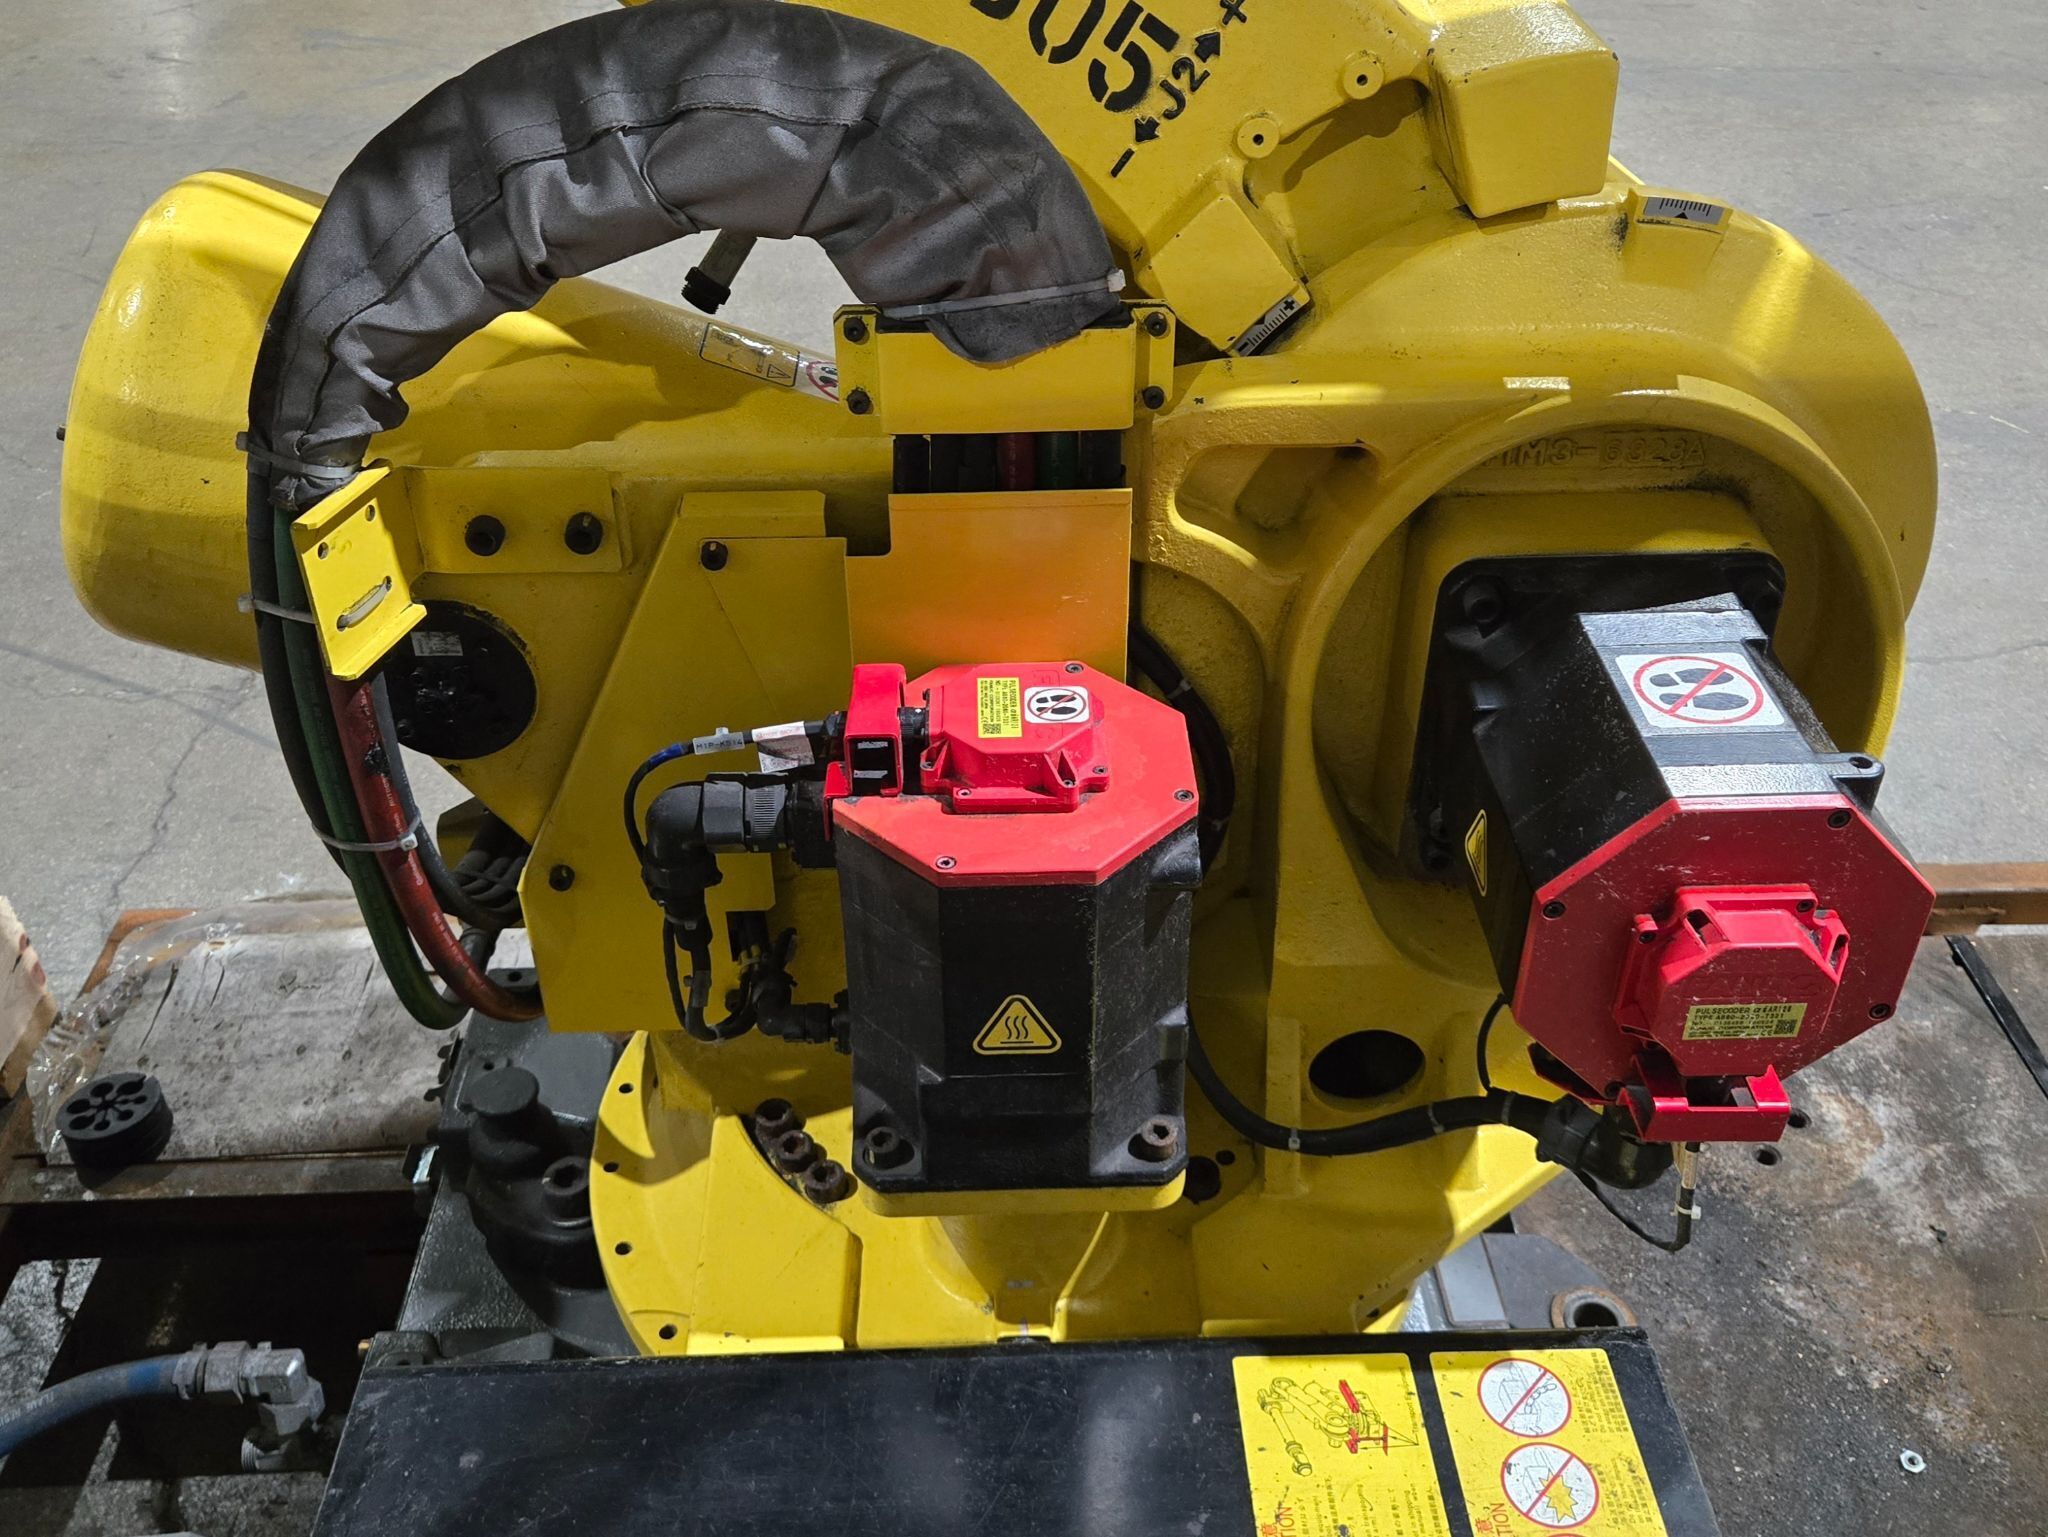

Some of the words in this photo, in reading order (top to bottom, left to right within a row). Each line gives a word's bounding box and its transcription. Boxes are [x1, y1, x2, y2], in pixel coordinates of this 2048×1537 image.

[970, 0, 1179, 112] 05
[1160, 56, 1211, 120] J2
[1696, 1007, 1750, 1015] PULSECODER
